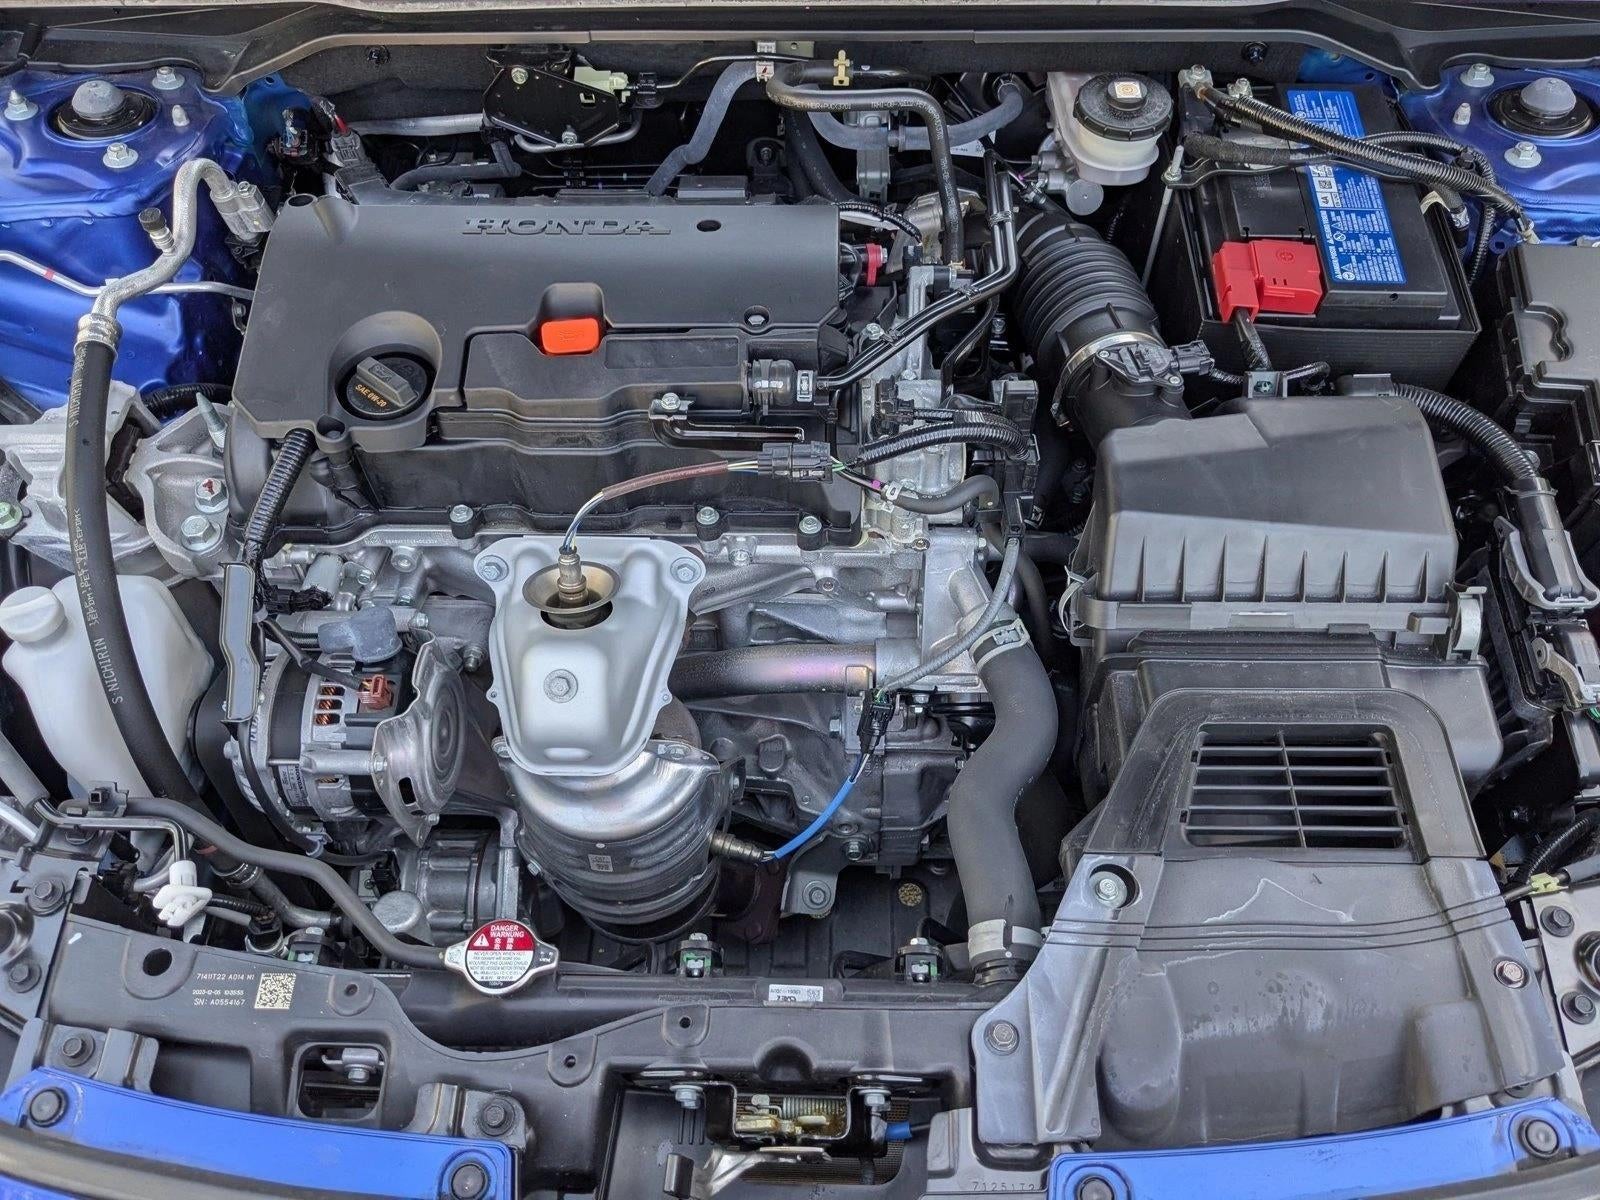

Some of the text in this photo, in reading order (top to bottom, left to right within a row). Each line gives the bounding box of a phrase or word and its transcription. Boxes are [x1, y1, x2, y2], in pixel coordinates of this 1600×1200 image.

[461, 218, 672, 236] HONDA
[355, 384, 387, 407] SAE 0W-20
[491, 924, 519, 932] DANGER
